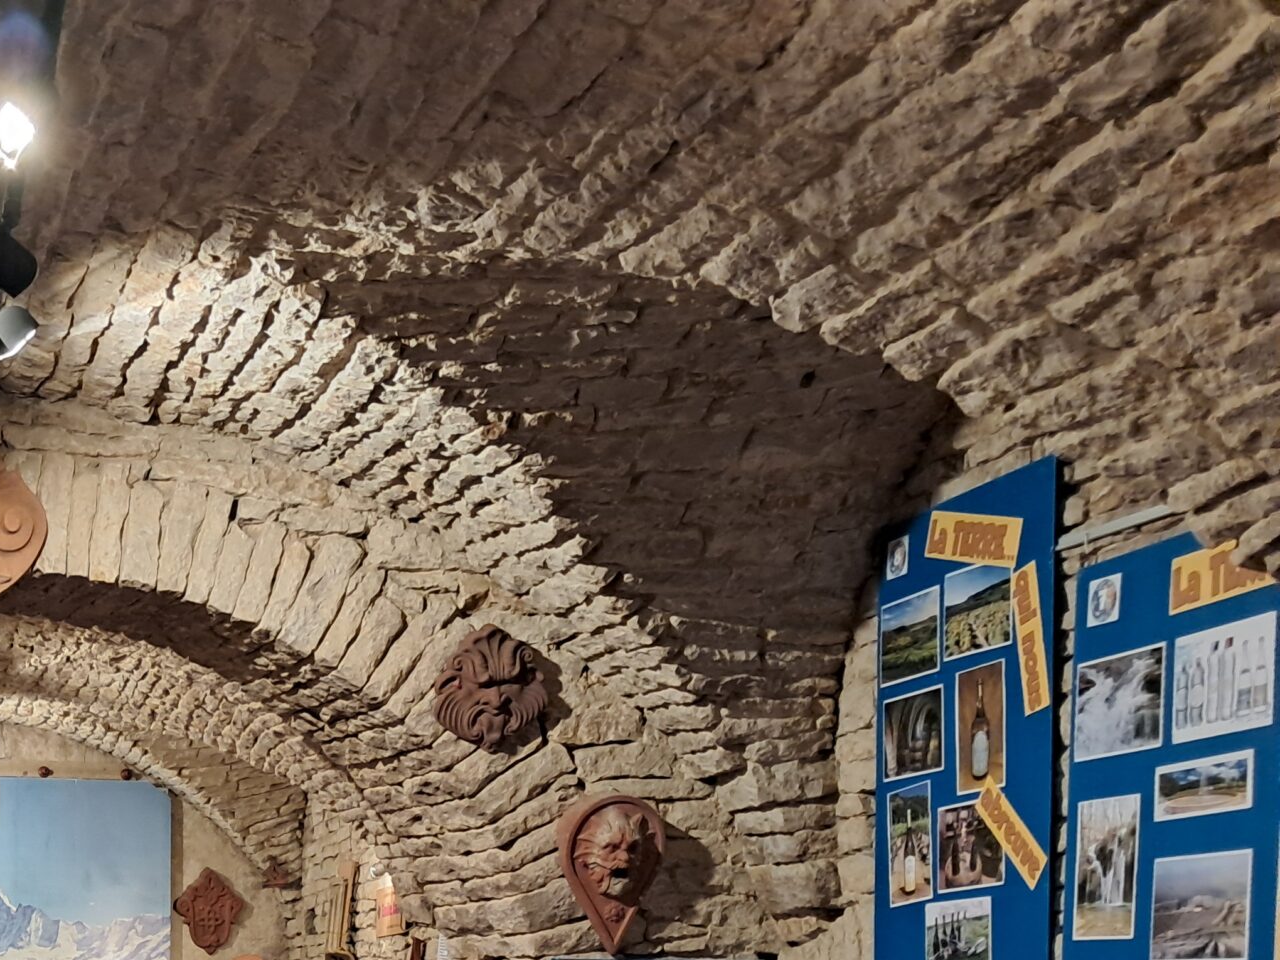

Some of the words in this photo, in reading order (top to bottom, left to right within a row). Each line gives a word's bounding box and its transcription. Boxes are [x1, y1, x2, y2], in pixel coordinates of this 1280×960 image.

[928, 519, 948, 555] La
[1013, 569, 1038, 626] qui
[1173, 566, 1200, 610] La
[1022, 630, 1042, 711] nous
[981, 787, 1041, 881] abreuve
